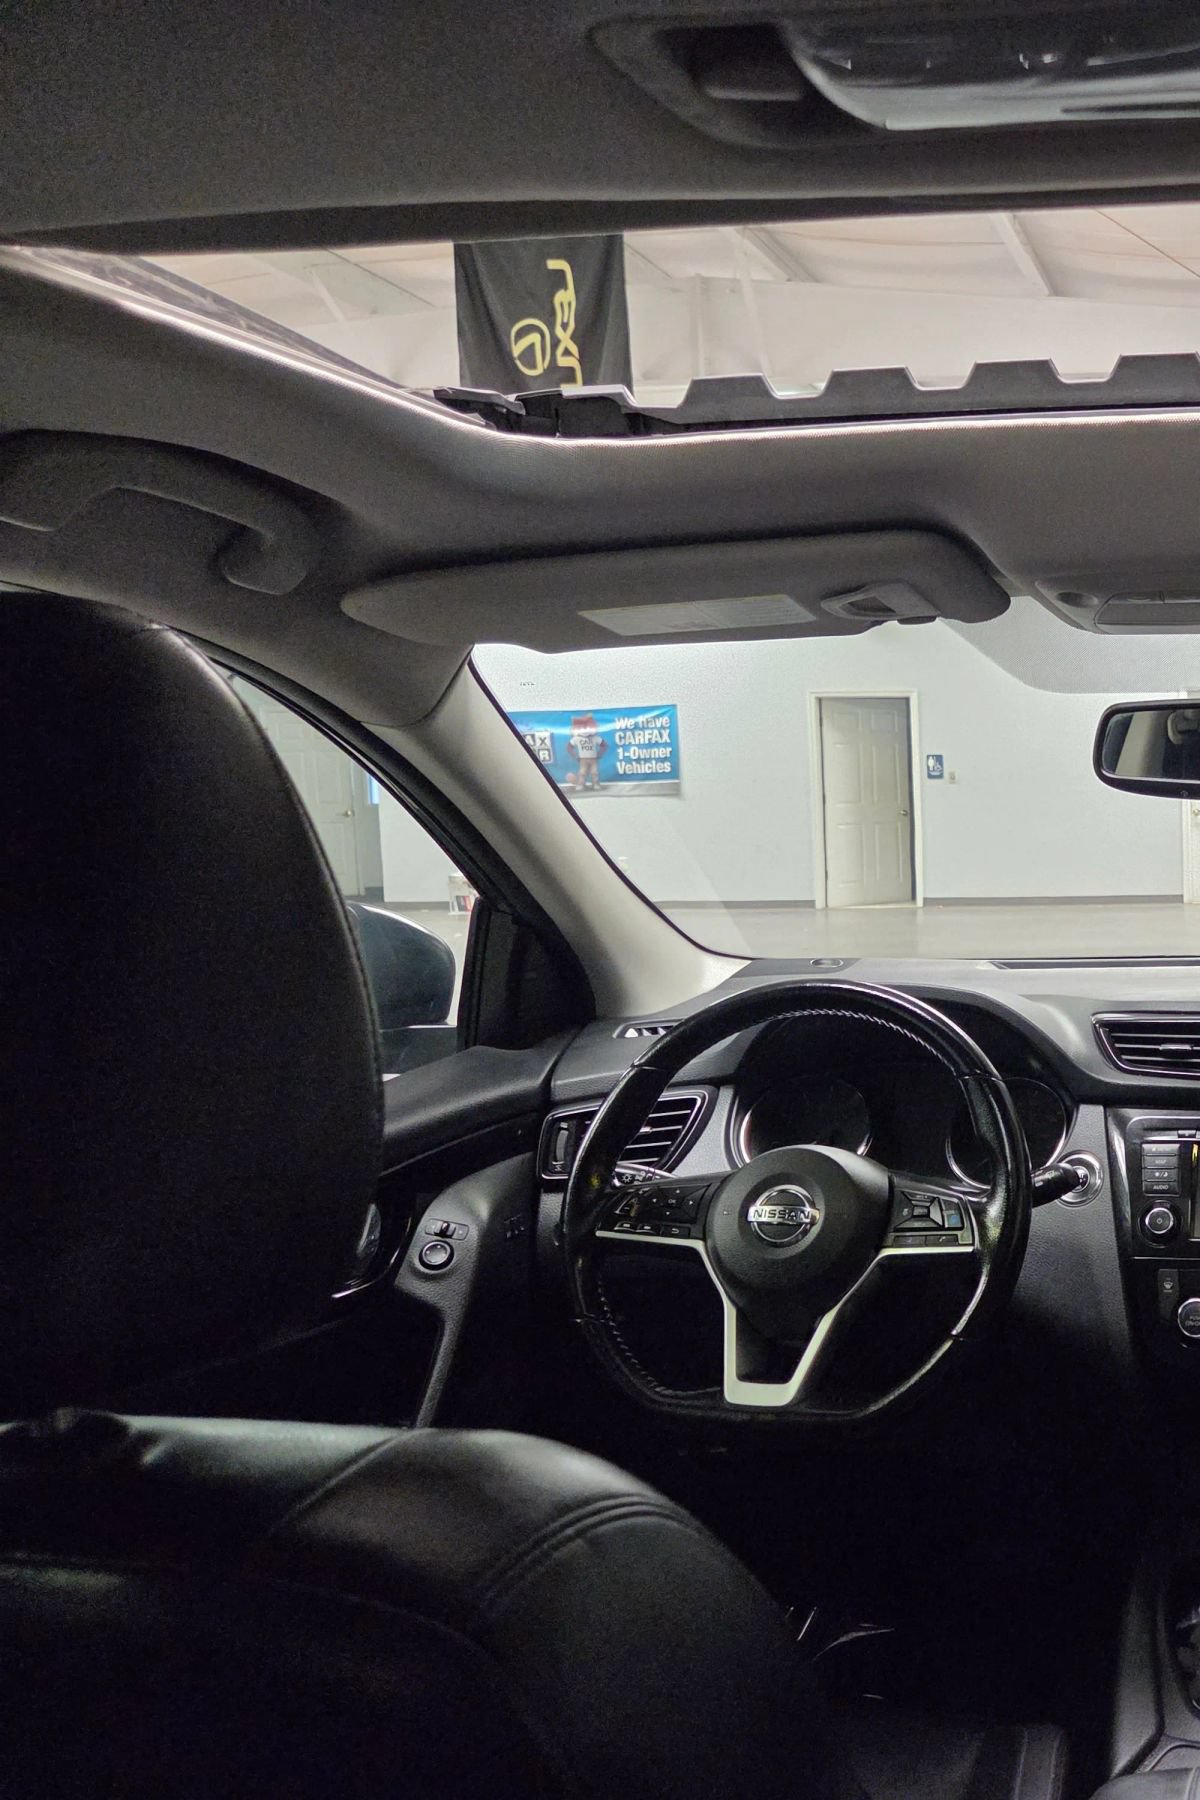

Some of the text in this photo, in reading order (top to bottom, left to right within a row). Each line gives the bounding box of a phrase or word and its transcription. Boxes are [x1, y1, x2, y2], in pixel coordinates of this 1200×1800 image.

[615, 715, 670, 730] We have
[615, 729, 671, 745] CARFAX
[617, 745, 672, 760] 1-Owner
[616, 760, 672, 774] Vehicles
[753, 1208, 810, 1220] NISSAN
